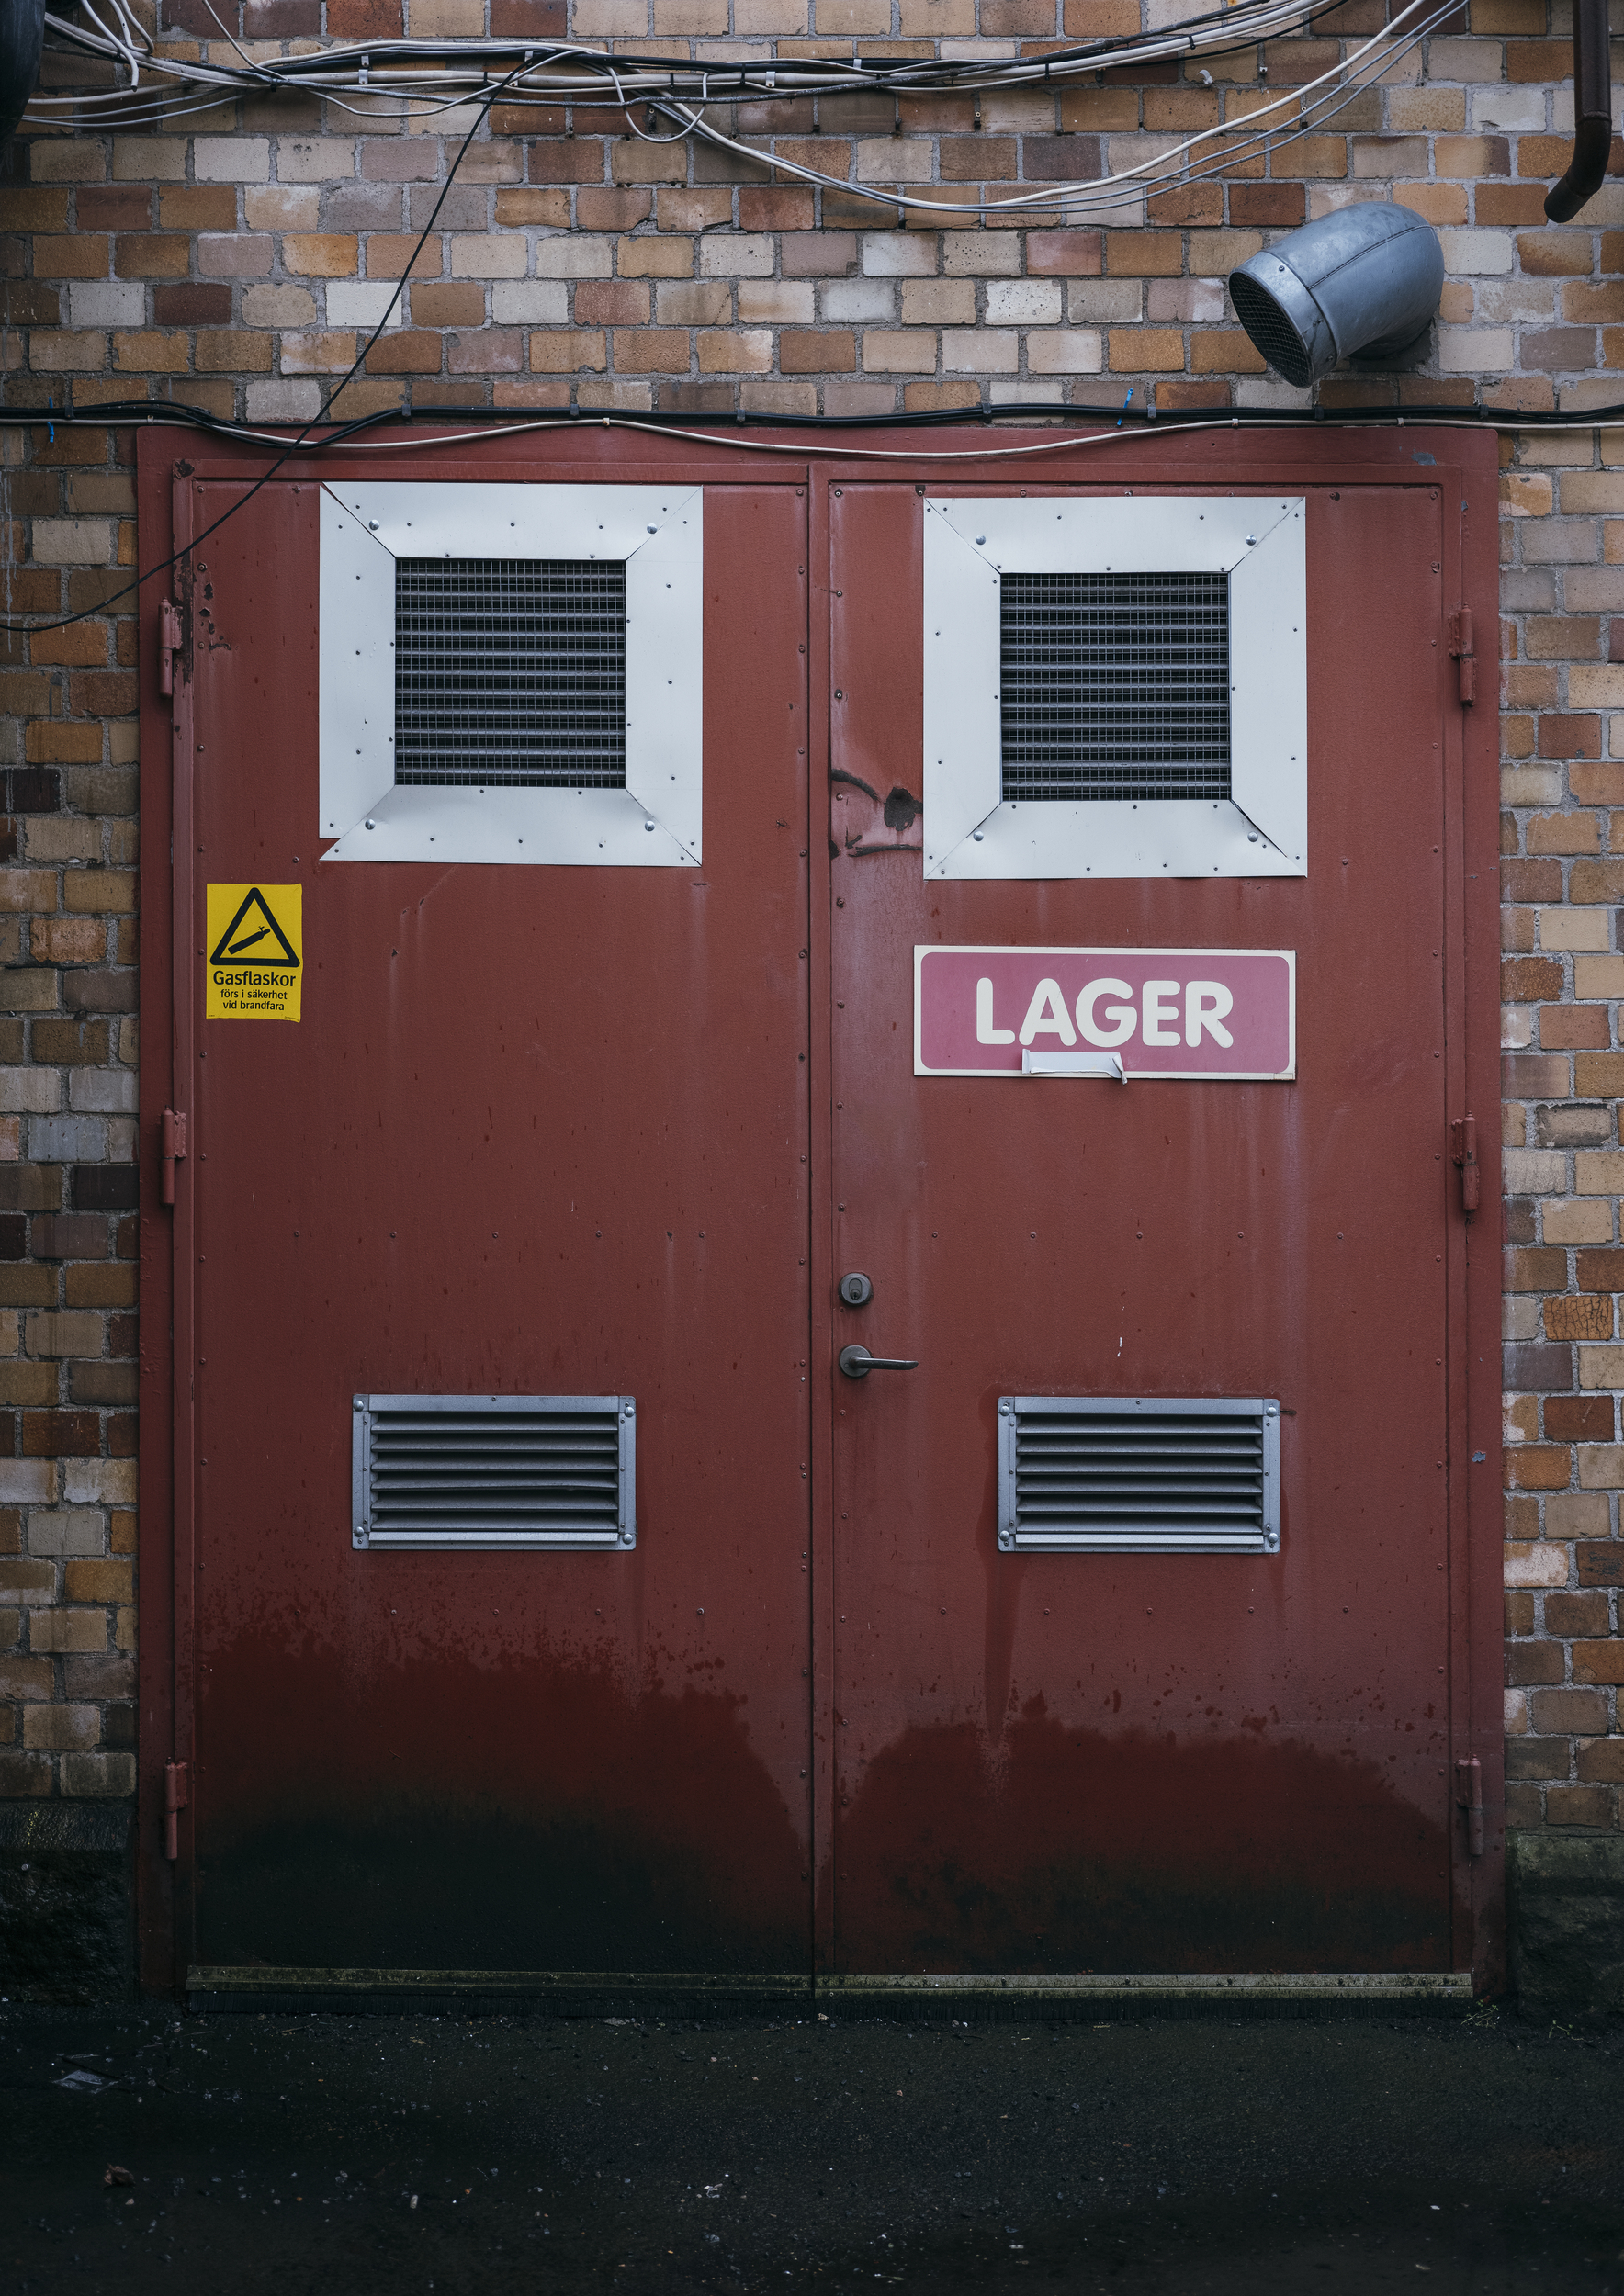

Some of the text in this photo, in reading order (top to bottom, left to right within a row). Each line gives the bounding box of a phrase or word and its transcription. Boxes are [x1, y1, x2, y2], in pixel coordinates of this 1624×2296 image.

[213, 970, 296, 987] Gasflaskor
[220, 989, 239, 998] förs
[247, 990, 288, 999] säkerhet
[222, 1000, 285, 1010] vid brandfara
[976, 977, 1234, 1049] LAGER
